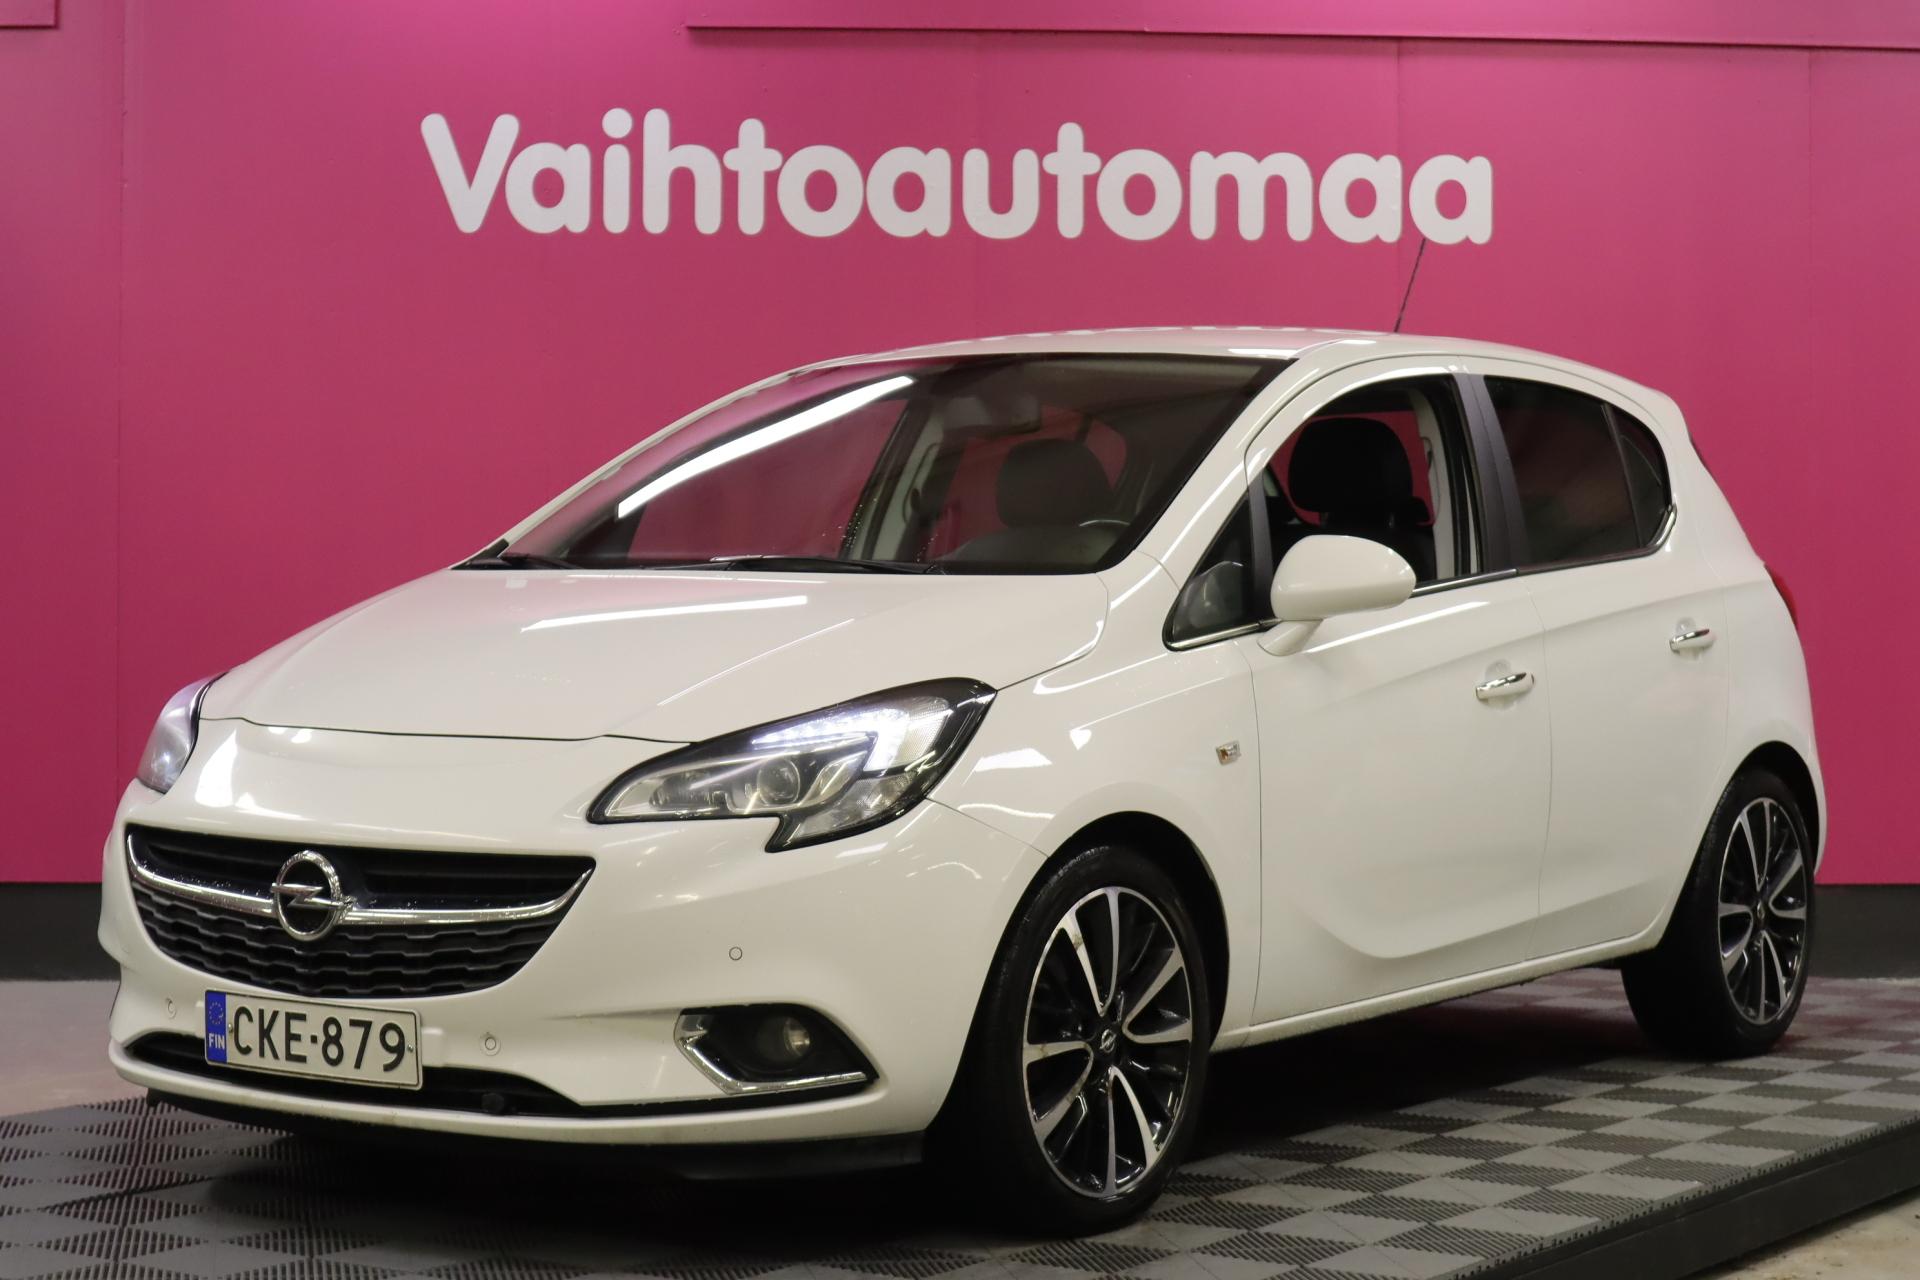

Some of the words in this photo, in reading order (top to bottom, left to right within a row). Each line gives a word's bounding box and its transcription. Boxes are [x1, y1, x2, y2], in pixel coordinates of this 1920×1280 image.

[421, 108, 1494, 245] Vaihtoautomaa
[208, 1033, 225, 1050] FIN
[234, 1006, 406, 1072] CKE-879
